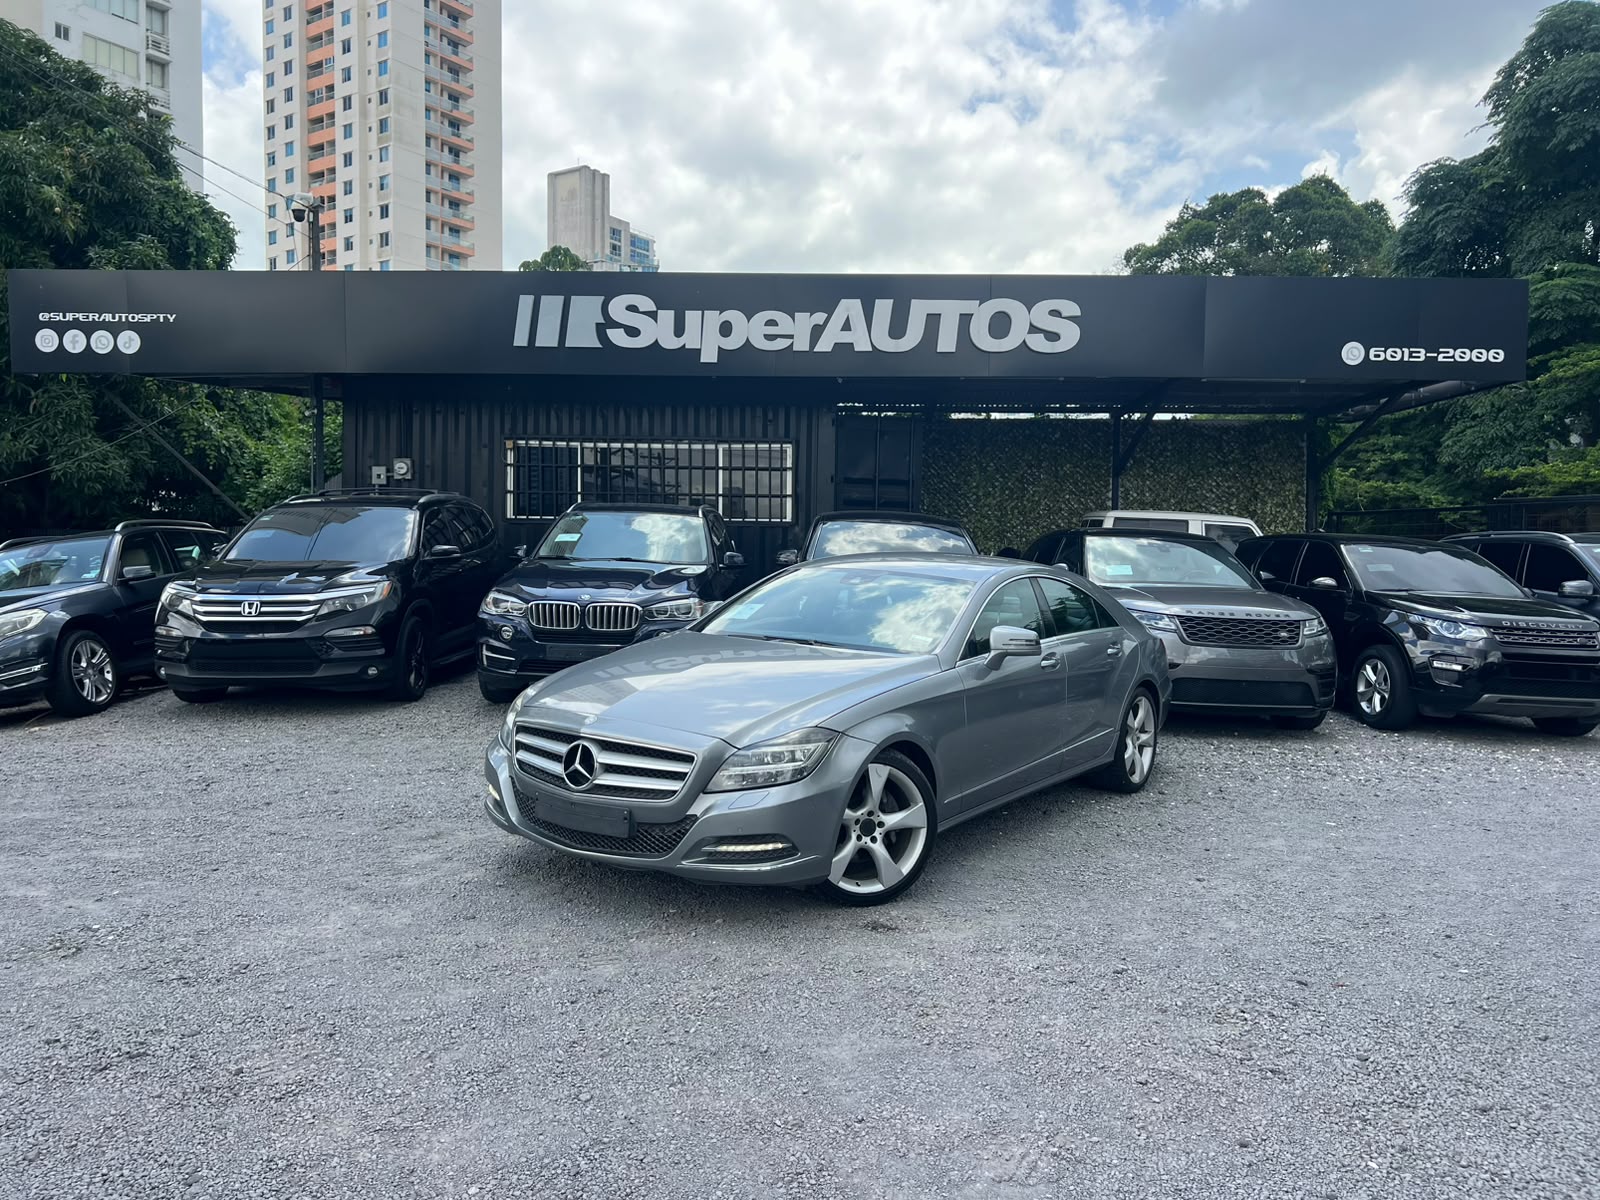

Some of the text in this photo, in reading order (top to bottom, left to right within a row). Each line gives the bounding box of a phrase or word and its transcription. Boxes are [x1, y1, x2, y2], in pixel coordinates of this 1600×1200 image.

[38, 312, 177, 323] @SUPERAUTOSPTY
[605, 293, 1081, 363] SuperAUTOS
[1369, 347, 1505, 363] 6013-2000
[1185, 609, 1236, 618] RANGE
[1502, 620, 1583, 629] DISCOVERY
